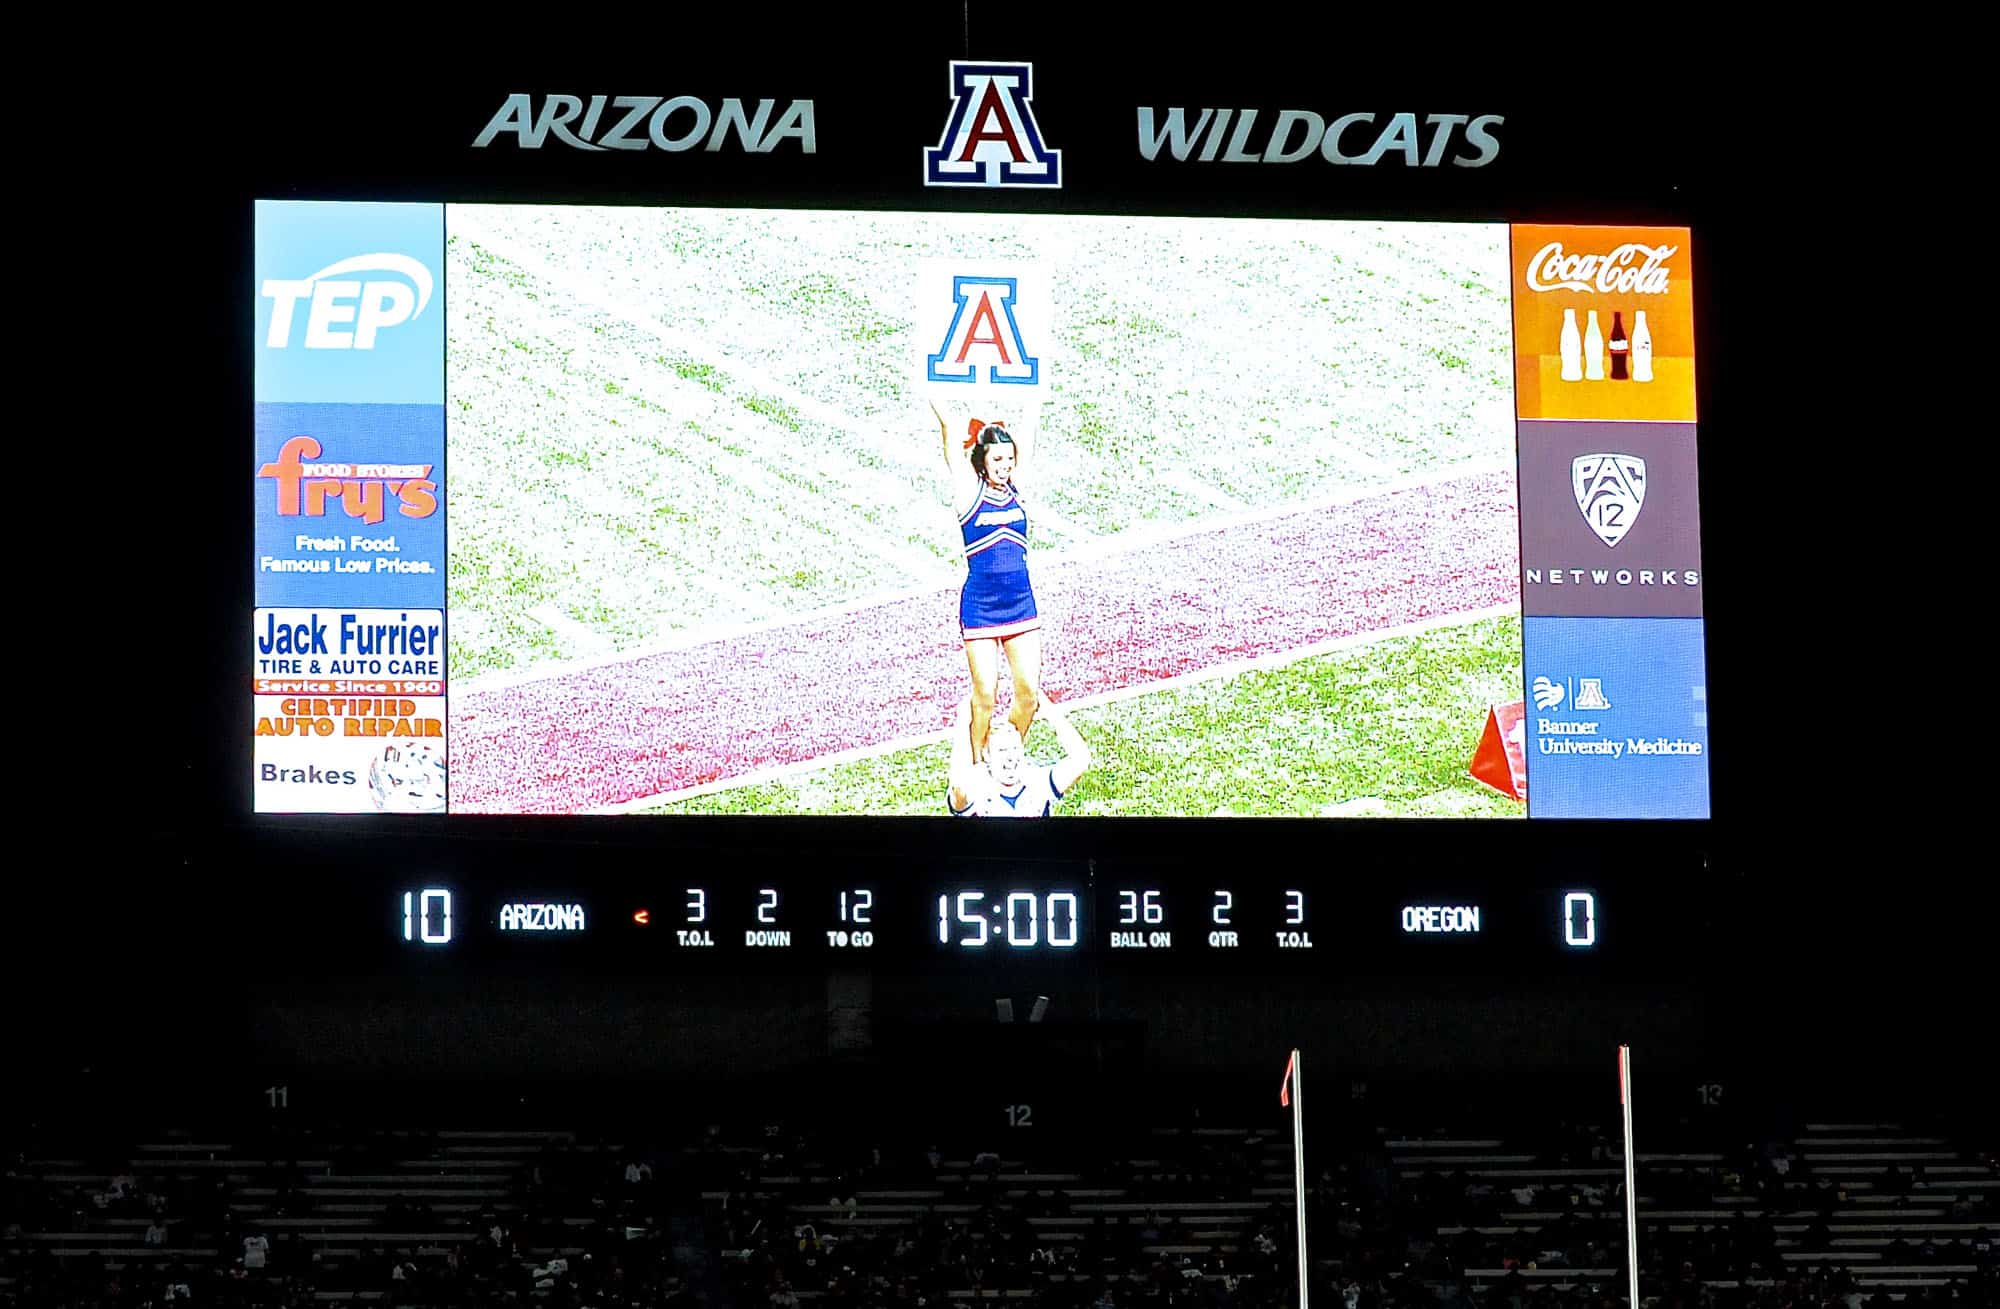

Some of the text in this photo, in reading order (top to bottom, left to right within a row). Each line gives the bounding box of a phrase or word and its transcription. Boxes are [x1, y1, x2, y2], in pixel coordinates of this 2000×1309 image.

[472, 93, 817, 154] ARIZONA
[923, 60, 1063, 190] A
[1137, 106, 1505, 168] WILDCATS
[262, 278, 420, 350] TEP
[928, 276, 1038, 384] A
[257, 436, 439, 525] fry's
[1599, 502, 1624, 527] 12
[295, 535, 401, 552] Fresh Food.
[260, 557, 436, 573] Famous Low Prices.
[1526, 569, 1700, 586] NETWORKS
[258, 613, 439, 656] Jack Furrier
[259, 659, 439, 675] TIRE & AUTO CARE
[258, 680, 441, 694] Service Since 1960
[280, 698, 416, 716] CERTIFIED
[255, 717, 443, 738] AUTO REPAIR
[1538, 719, 1599, 735] Banner
[1539, 738, 1702, 759] University Medicine
[261, 763, 357, 785] Brakes
[403, 887, 452, 944] 10
[500, 904, 585, 931] ARIZONA
[686, 889, 706, 922] 3
[757, 889, 778, 922] 2
[840, 889, 873, 922] 12
[1119, 891, 1163, 924] 36
[1213, 891, 1233, 924] 2
[1285, 891, 1304, 924] 3
[937, 890, 1080, 950] 15:00
[1402, 906, 1480, 932] OREGON
[1562, 892, 1596, 946] 0
[677, 931, 714, 947] T.O.L
[746, 931, 791, 947] DOWN
[826, 931, 874, 947] TO GO
[1111, 932, 1171, 948] BALL ON
[1208, 931, 1239, 948] QTR
[1276, 932, 1313, 948] T.O.L
[265, 1086, 288, 1109] 11
[1003, 1104, 1033, 1128] 12
